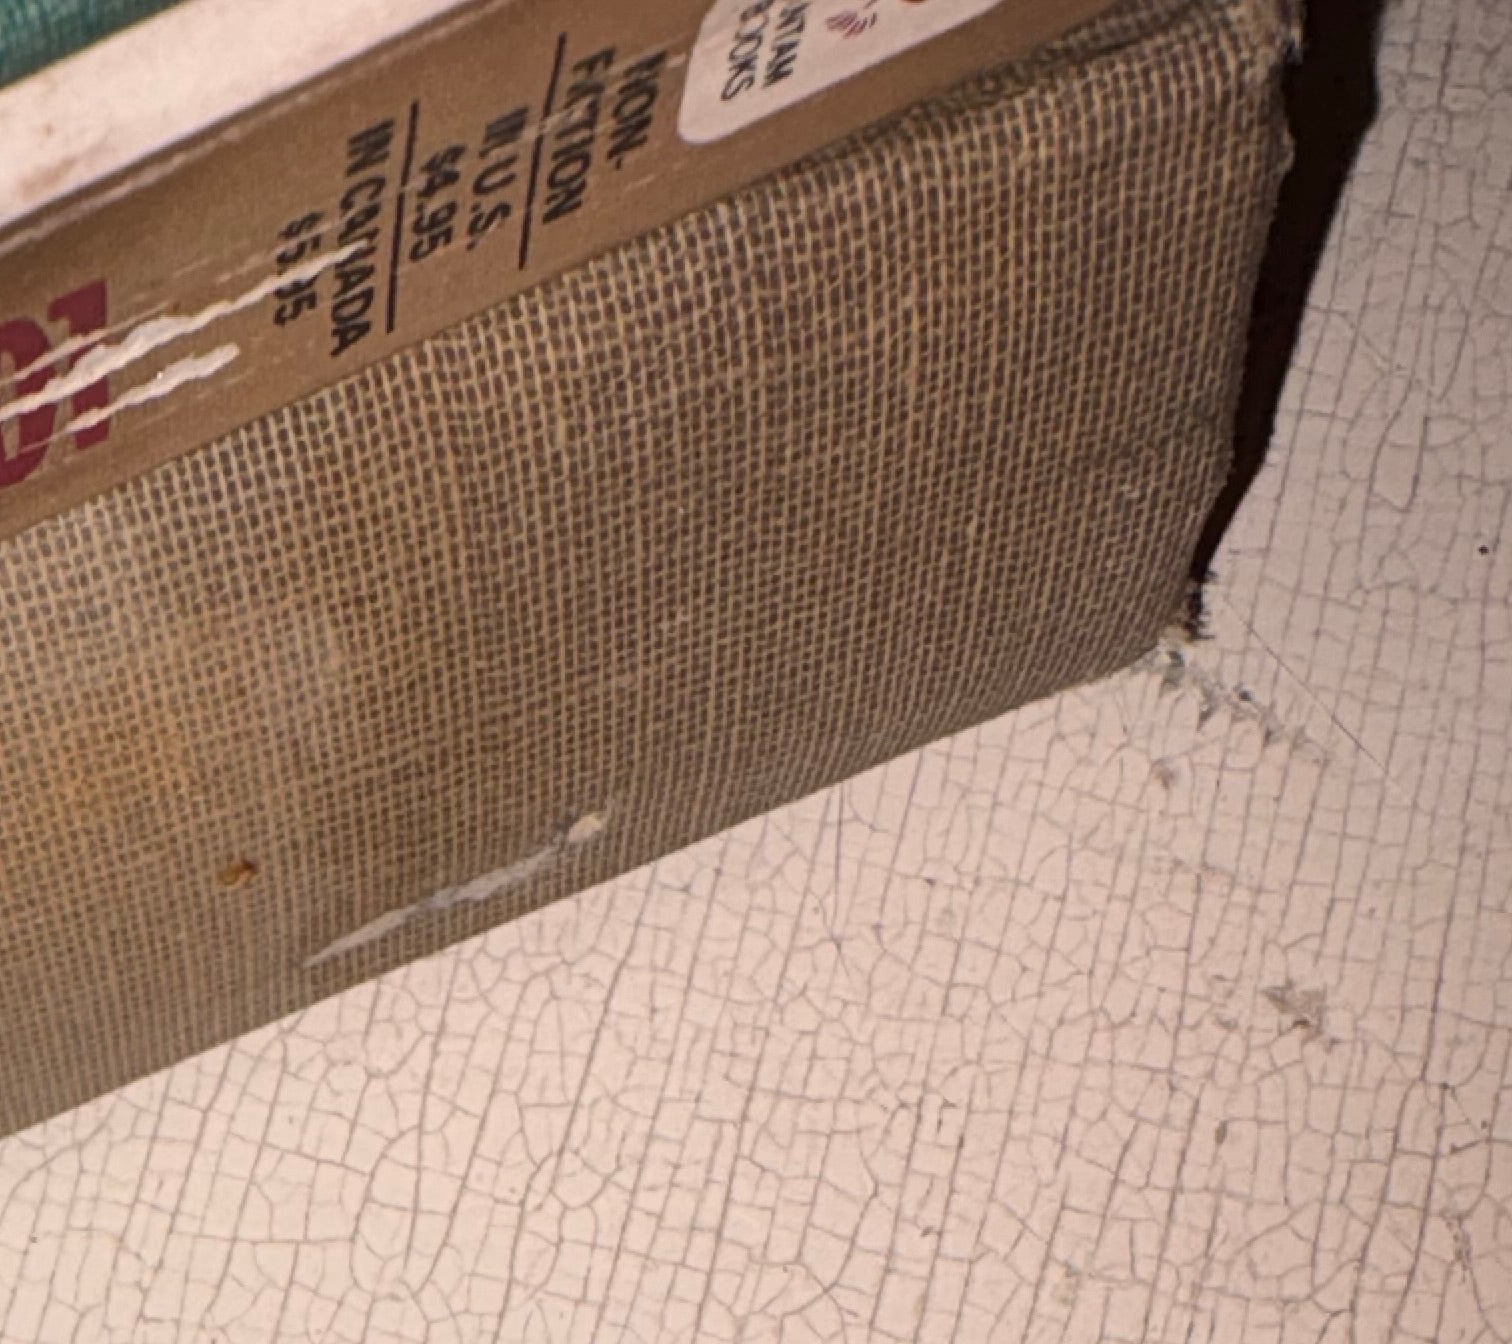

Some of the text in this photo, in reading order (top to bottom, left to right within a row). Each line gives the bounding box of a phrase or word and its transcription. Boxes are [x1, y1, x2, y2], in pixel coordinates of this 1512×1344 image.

[542, 46, 617, 226] FICTION
[608, 50, 668, 171] NON-
[329, 118, 394, 358] IN CANADA
[408, 144, 467, 263] $4.95
[466, 152, 520, 252] U.S.
